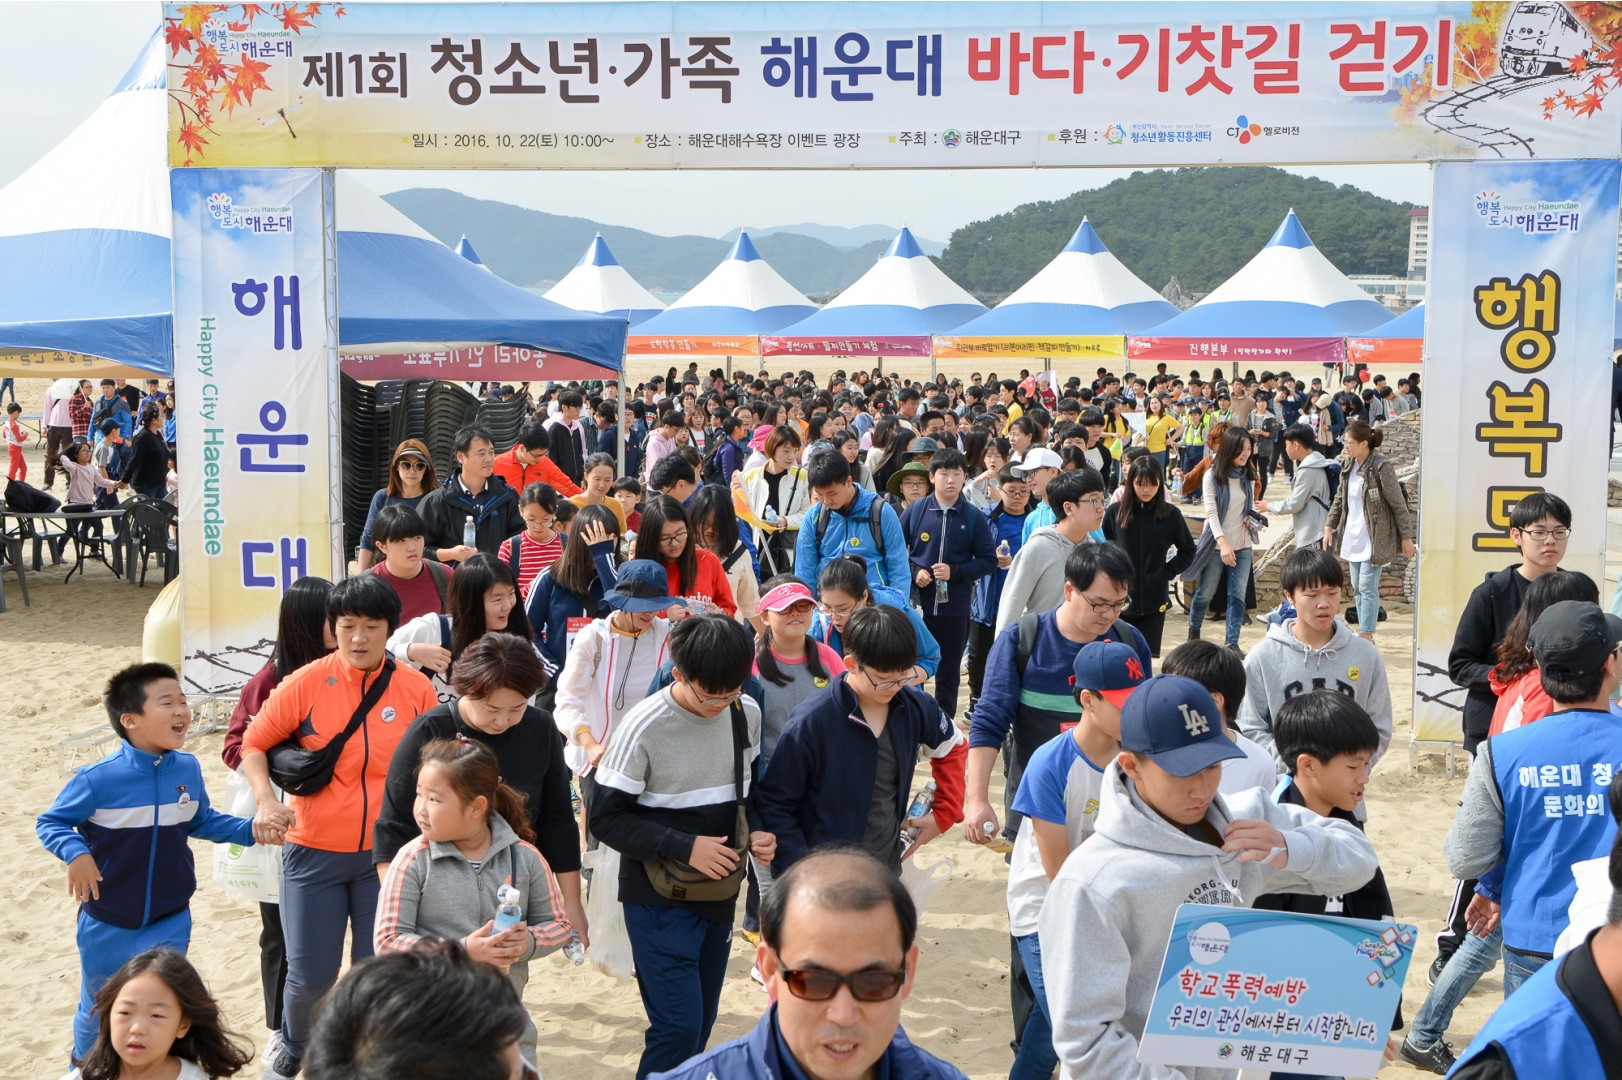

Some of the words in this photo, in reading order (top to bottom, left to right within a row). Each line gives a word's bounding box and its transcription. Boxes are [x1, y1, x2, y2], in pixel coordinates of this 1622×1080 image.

[206, 30, 228, 43] 행복
[219, 42, 240, 52] 도시
[241, 41, 293, 58] 해운대
[302, 51, 409, 99] 제1회
[430, 37, 740, 105] 청소년·가족
[760, 32, 943, 102] 해운대
[967, 23, 1300, 97] 바다·기찻길
[1329, 20, 1452, 92] 걷기
[411, 133, 439, 148] 일시
[454, 134, 490, 149] 2016.
[495, 134, 515, 149] 10.
[519, 133, 558, 149] 22(토)
[563, 134, 615, 148] 10:00~
[645, 133, 672, 149] 장소
[688, 133, 782, 149] 해운대해수욕장
[787, 133, 827, 148] 이벤트
[832, 133, 861, 149] 광장
[899, 130, 927, 146] 주최
[965, 130, 1022, 146] 해운대구
[1058, 129, 1087, 145] 후원
[1130, 131, 1212, 144] 청소년활동진흥센터
[1226, 127, 1240, 139] CJ
[1263, 126, 1300, 136] 헬로비전
[210, 203, 232, 217] 행복
[1476, 202, 1502, 216] 행복
[223, 216, 244, 227] 도시
[245, 216, 292, 233] 해운대
[1488, 215, 1513, 226] 도시
[1516, 213, 1579, 232] 해운대
[196, 316, 217, 378] Happy
[1189, 343, 1229, 357] 진행본부
[200, 383, 218, 421] City
[202, 427, 225, 556] Haeundae
[1178, 703, 1210, 737] LA
[1518, 764, 1583, 788] 해운대
[1543, 793, 1605, 818] 문화의
[1180, 968, 1307, 1005] 학교폭력예방
[1169, 1005, 1211, 1029] 우리의
[1216, 1007, 1300, 1035] 관심에서부터
[1303, 1014, 1377, 1042] 시작합니다.
[1240, 1044, 1309, 1065] 해운대구
